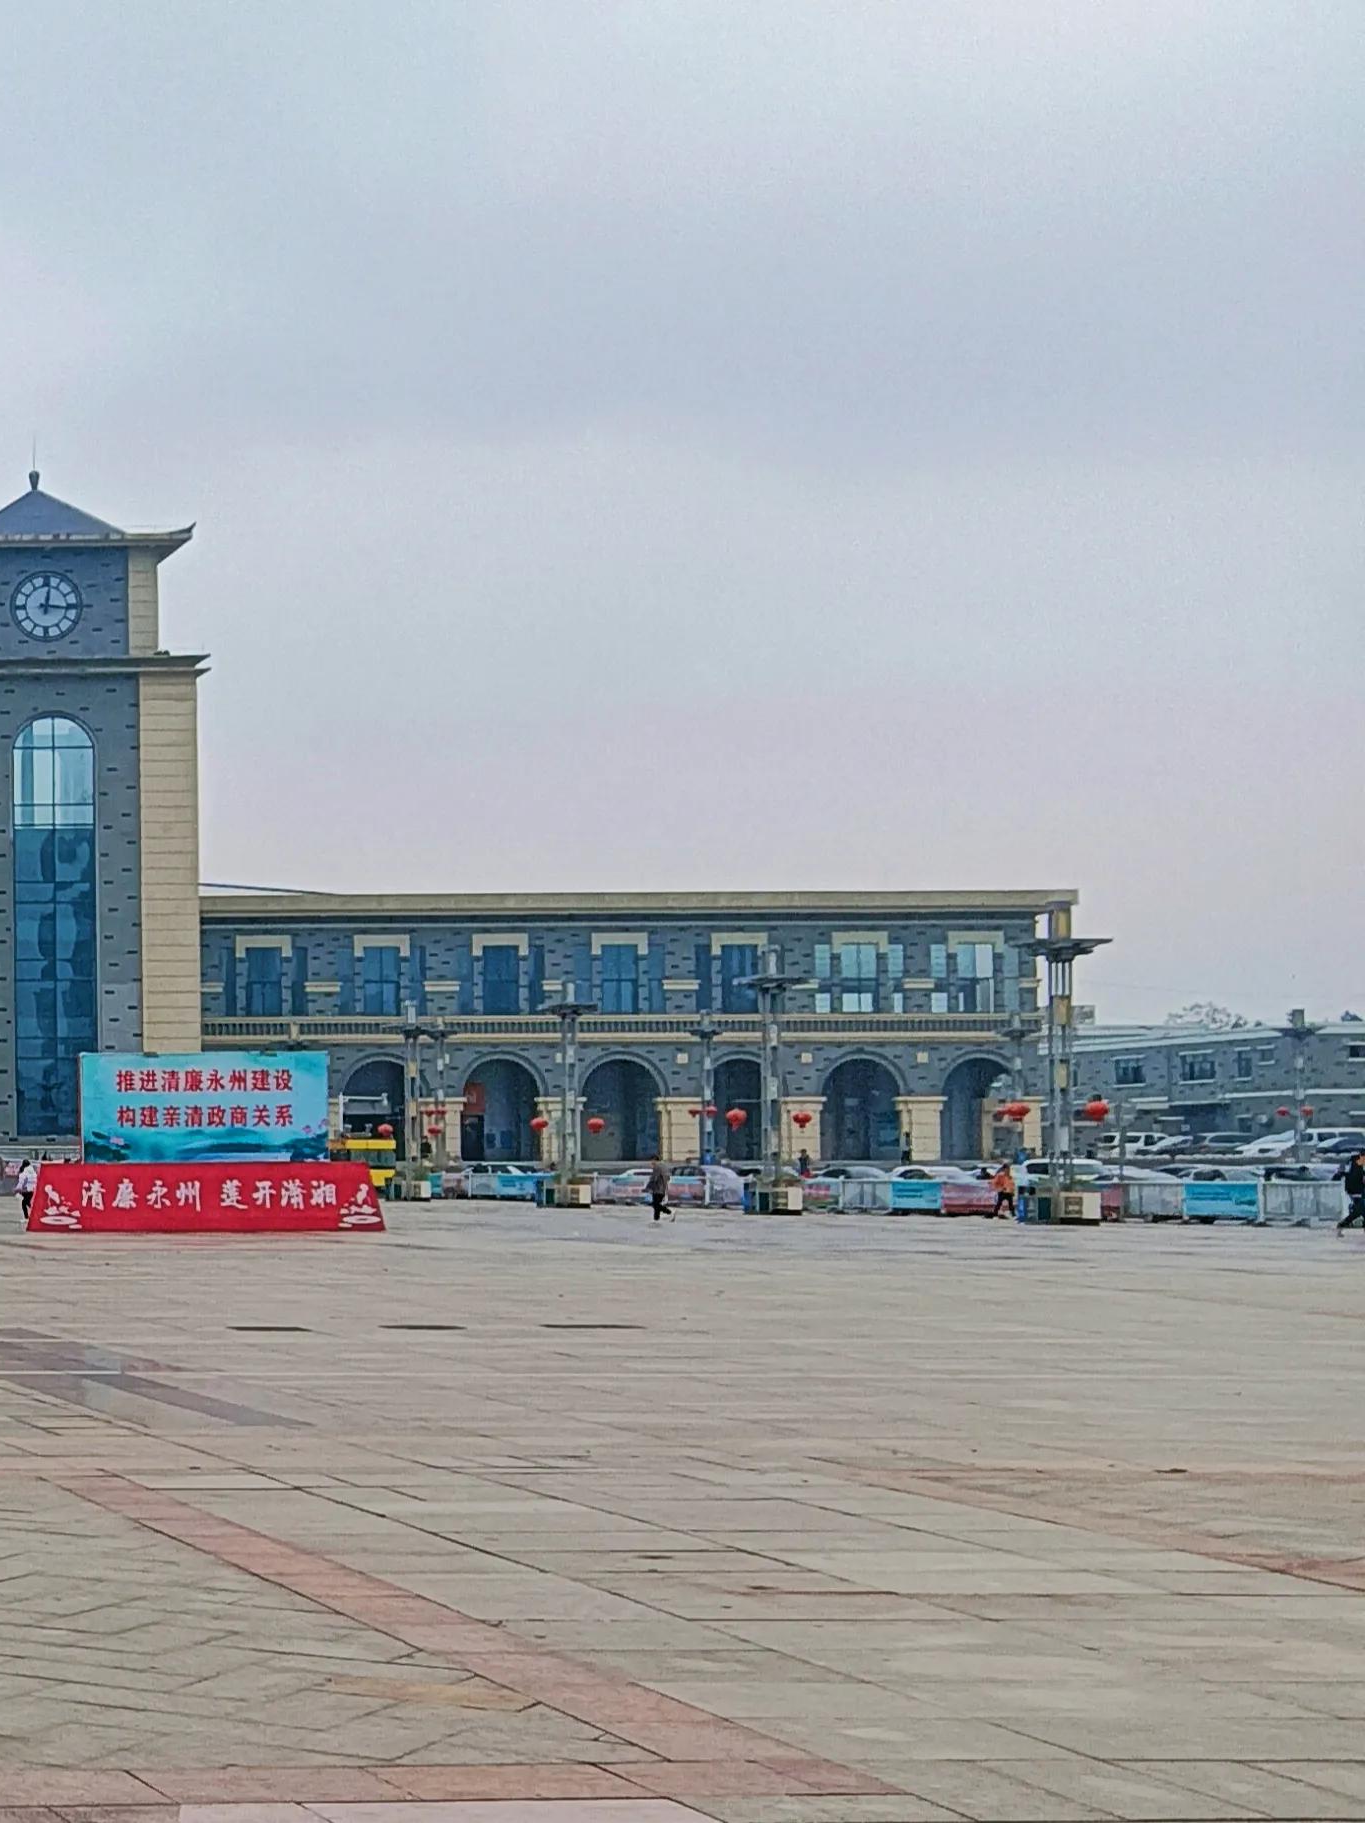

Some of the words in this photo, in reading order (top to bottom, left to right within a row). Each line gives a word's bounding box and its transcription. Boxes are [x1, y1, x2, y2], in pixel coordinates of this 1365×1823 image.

[116, 1069, 293, 1093] 推进清廉永州建设
[117, 1104, 293, 1128] 构建亲清政商关系
[81, 1180, 202, 1211] 清廉永州
[220, 1179, 337, 1210] 莲开潇湘
